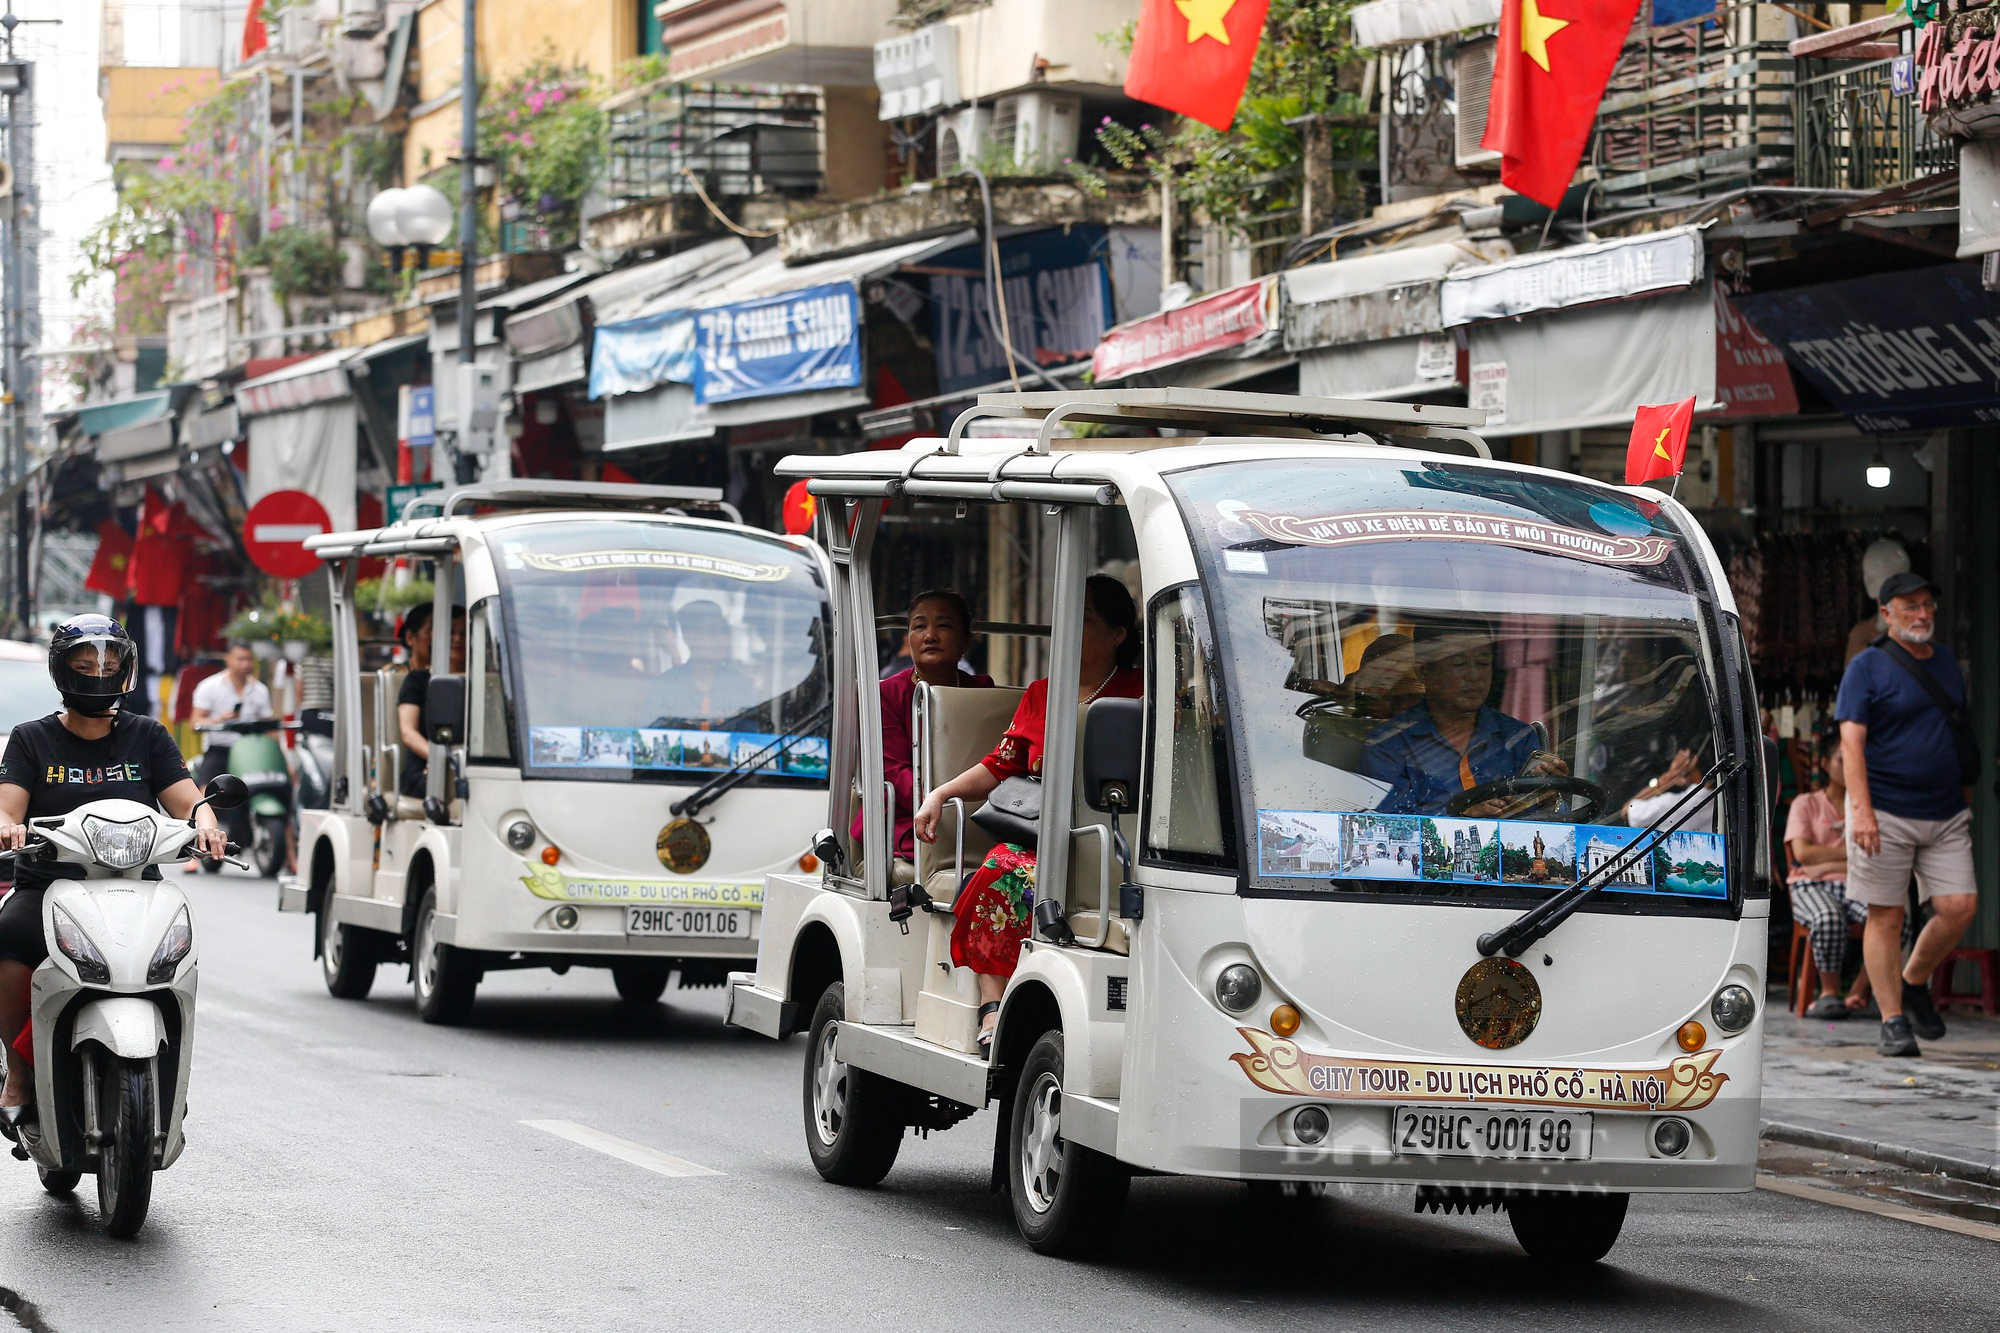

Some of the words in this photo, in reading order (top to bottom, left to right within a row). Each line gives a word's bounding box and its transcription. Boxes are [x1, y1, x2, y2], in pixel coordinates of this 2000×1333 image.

[1893, 60, 1908, 91] 62
[699, 310, 737, 372] 72
[735, 304, 792, 362] SINH
[793, 294, 852, 352] SINH
[930, 275, 976, 378] 72
[1308, 519, 1342, 539] HÃY
[1343, 519, 1362, 534] ĐI
[1365, 518, 1386, 532] XE
[1388, 516, 1427, 535] ĐIỆN
[1428, 515, 1449, 531] ĐỂ
[1454, 516, 1487, 534] BẢO
[1489, 521, 1511, 539] VỆ
[1514, 524, 1547, 542] MÔI
[1550, 532, 1616, 557] TRƯỜNG
[46, 761, 142, 784] HOUSE
[566, 883, 596, 897] CITY
[598, 884, 630, 898] TOUR
[640, 886, 657, 899] DU
[630, 909, 738, 933] 29HC-001.06
[1309, 1067, 1354, 1091] CITY
[1358, 1068, 1411, 1093] TOUR
[1426, 1070, 1453, 1093] DU
[1459, 1071, 1503, 1101] LỊCH
[1509, 1069, 1551, 1098] PHỐ
[1554, 1069, 1585, 1099] CỔ
[1599, 1072, 1628, 1103] HÀ
[1632, 1076, 1666, 1109] NỘI
[1401, 1113, 1572, 1153] 29HC-001.98
